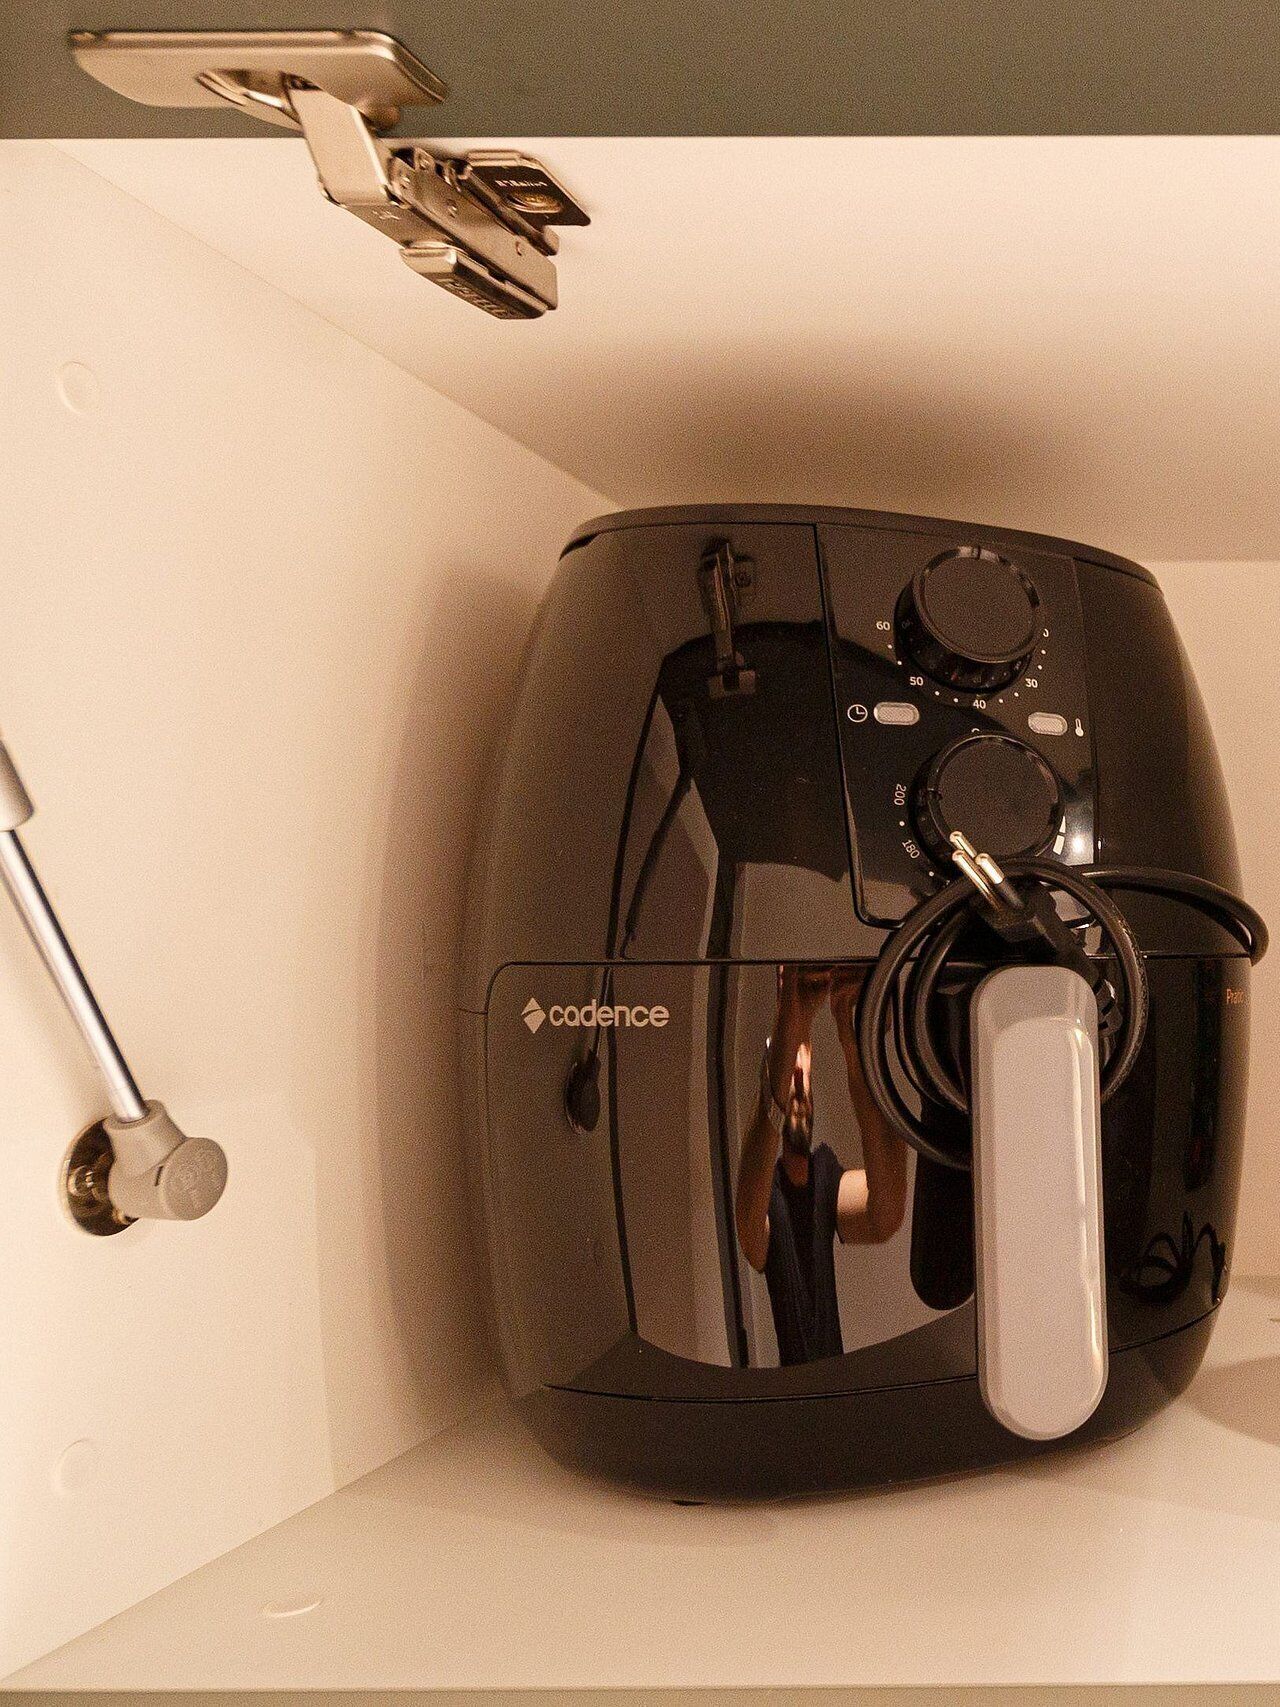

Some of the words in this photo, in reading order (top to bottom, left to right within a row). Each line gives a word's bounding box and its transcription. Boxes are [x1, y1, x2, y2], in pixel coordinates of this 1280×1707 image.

[876, 621, 891, 631] 60
[909, 676, 924, 687] 50
[1025, 678, 1038, 688] 30
[972, 699, 987, 710] 40
[893, 783, 907, 806] 200
[901, 838, 920, 859] 180
[549, 998, 670, 1028] cadence
